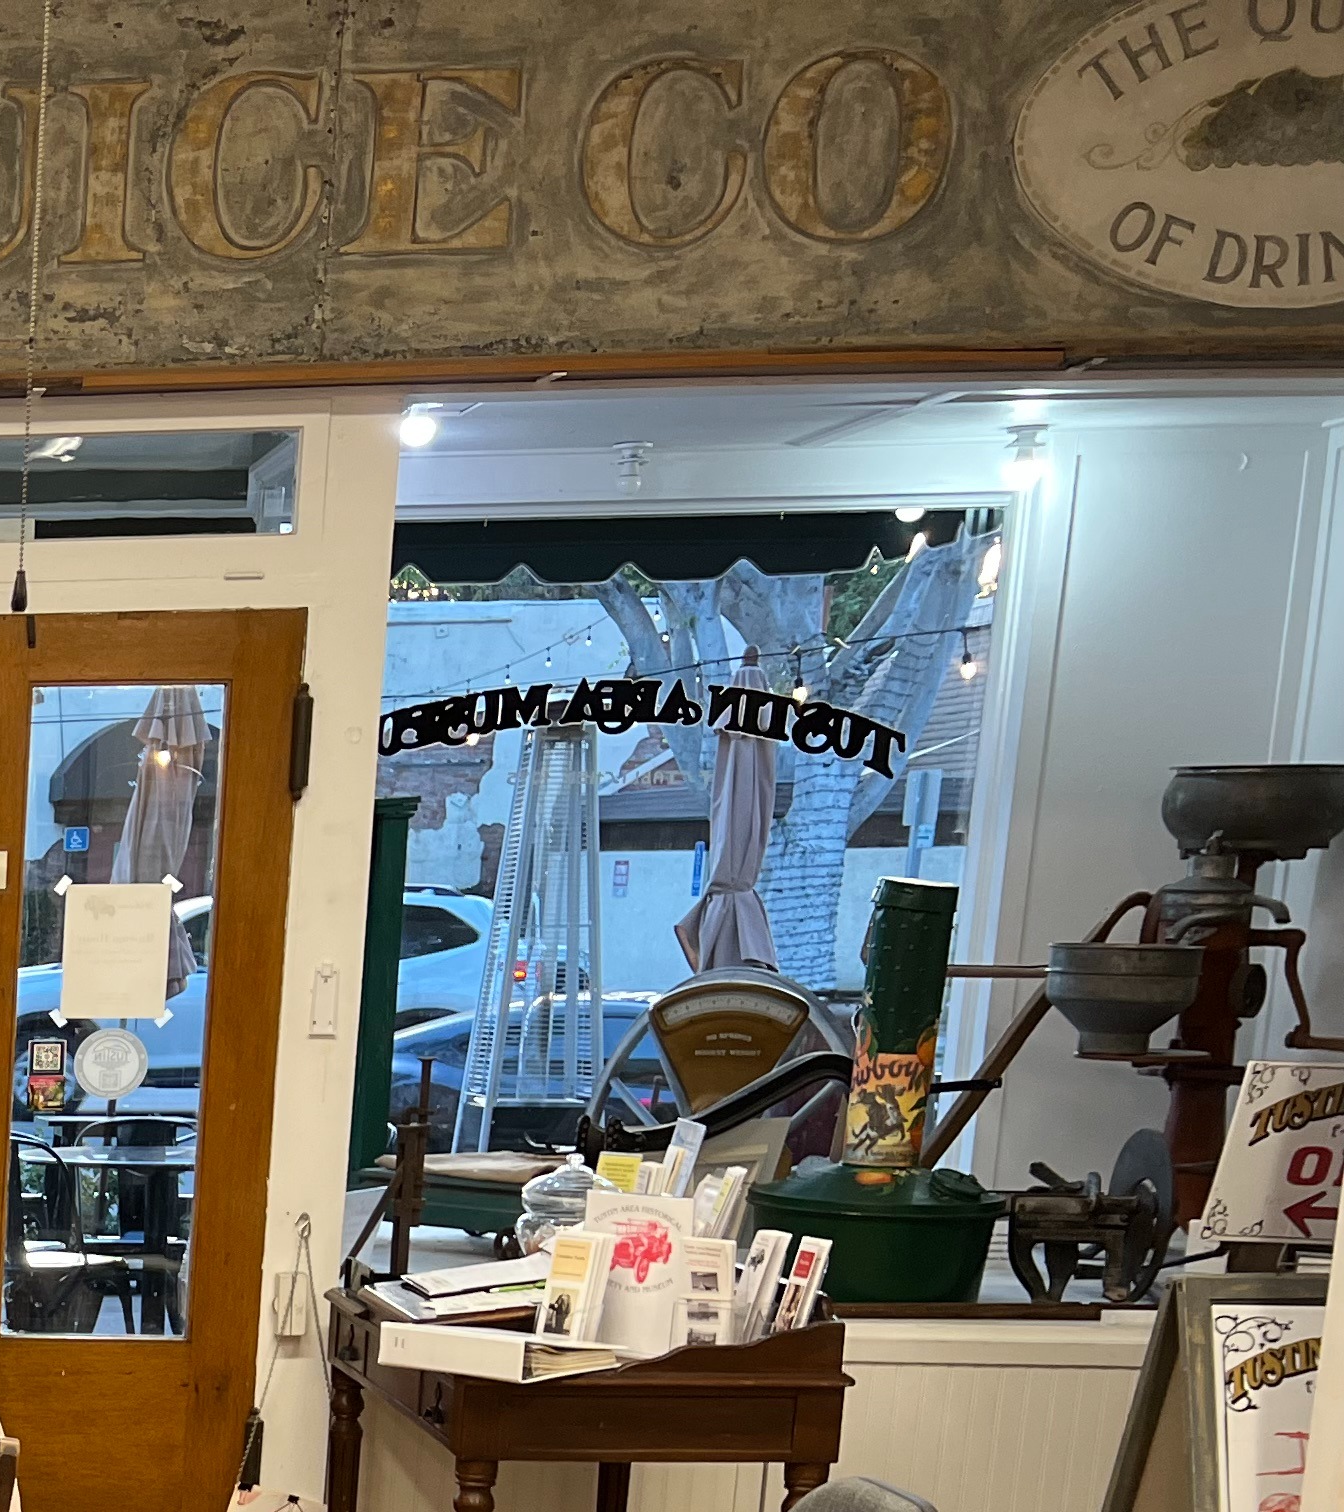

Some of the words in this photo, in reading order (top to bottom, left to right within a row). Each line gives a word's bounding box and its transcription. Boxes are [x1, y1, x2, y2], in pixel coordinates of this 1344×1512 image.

[1077, 1, 1219, 101] THE
[583, 48, 954, 248] CO
[1109, 202, 1196, 266] OF
[620, 1205, 640, 1213] AREA
